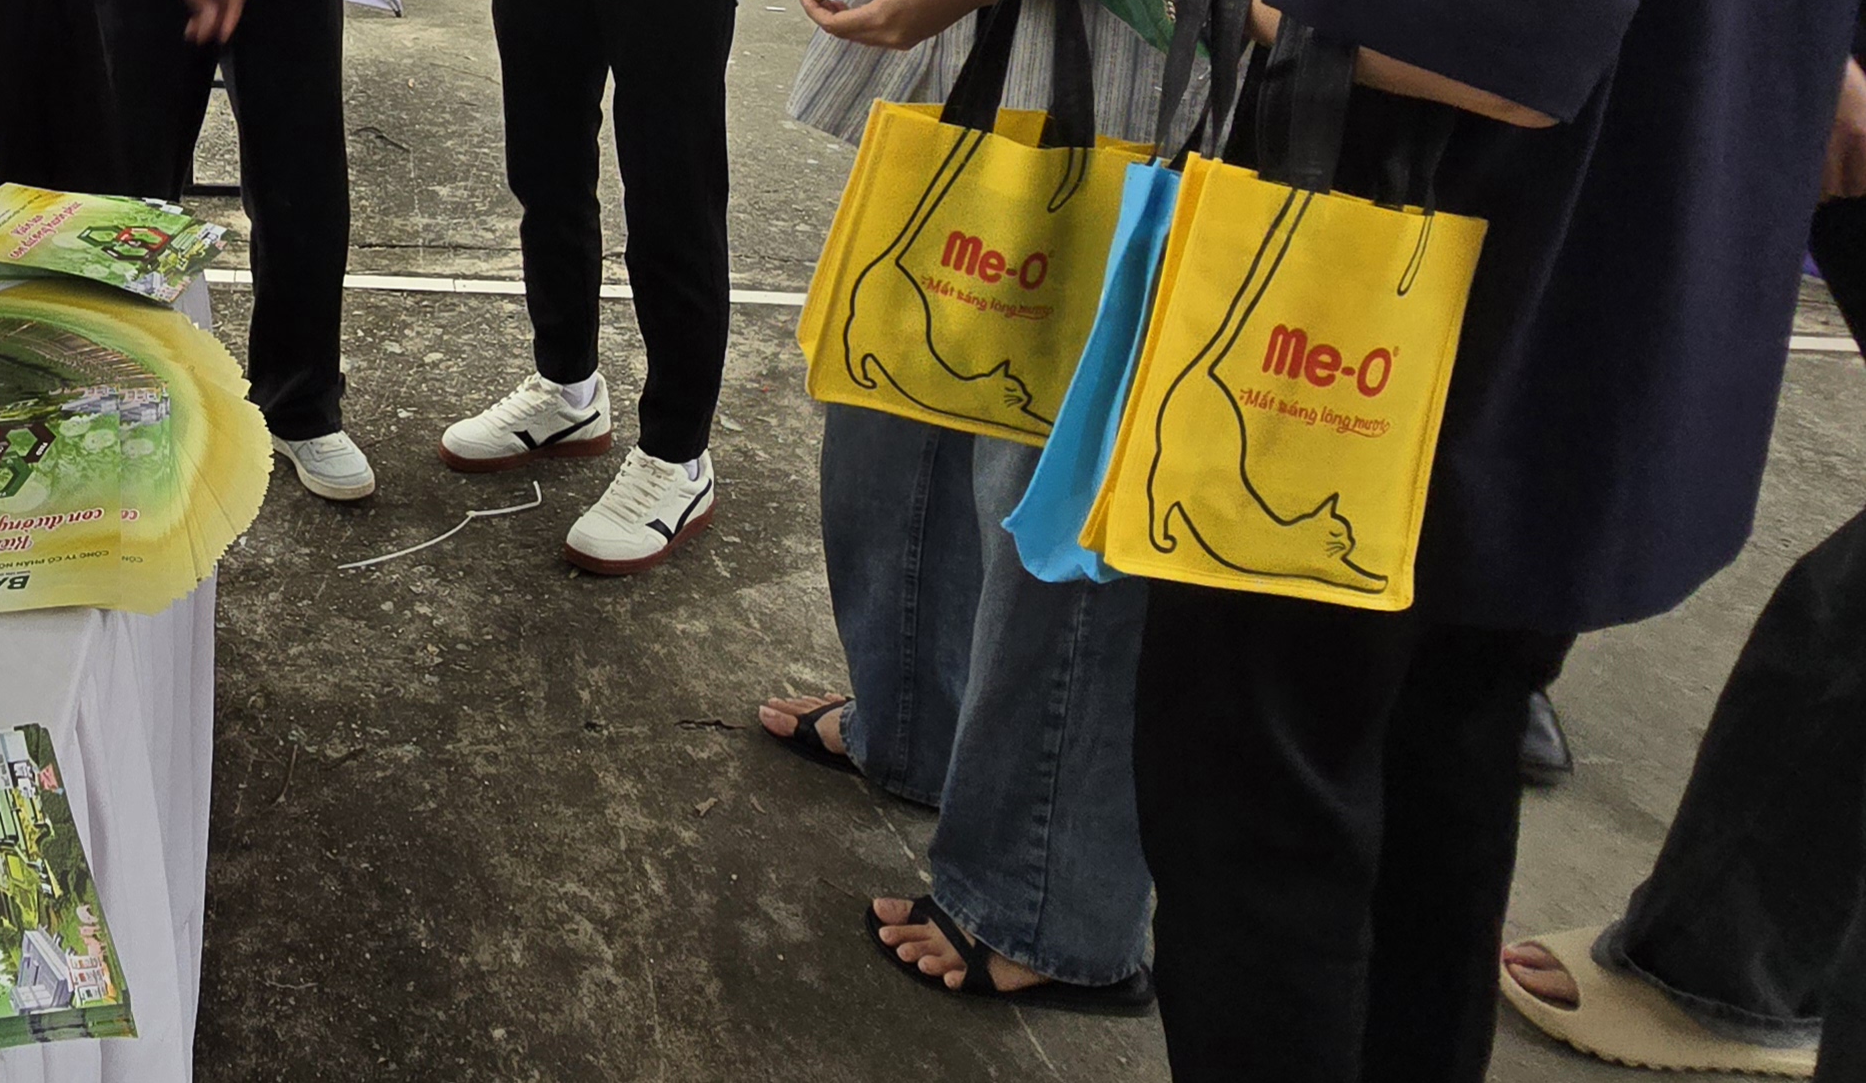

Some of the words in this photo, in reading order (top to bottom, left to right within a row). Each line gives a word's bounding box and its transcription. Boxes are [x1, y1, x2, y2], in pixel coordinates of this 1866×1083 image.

[941, 230, 1049, 291] Me-O
[1262, 323, 1393, 398] Me-O
[67, 507, 104, 522] con
